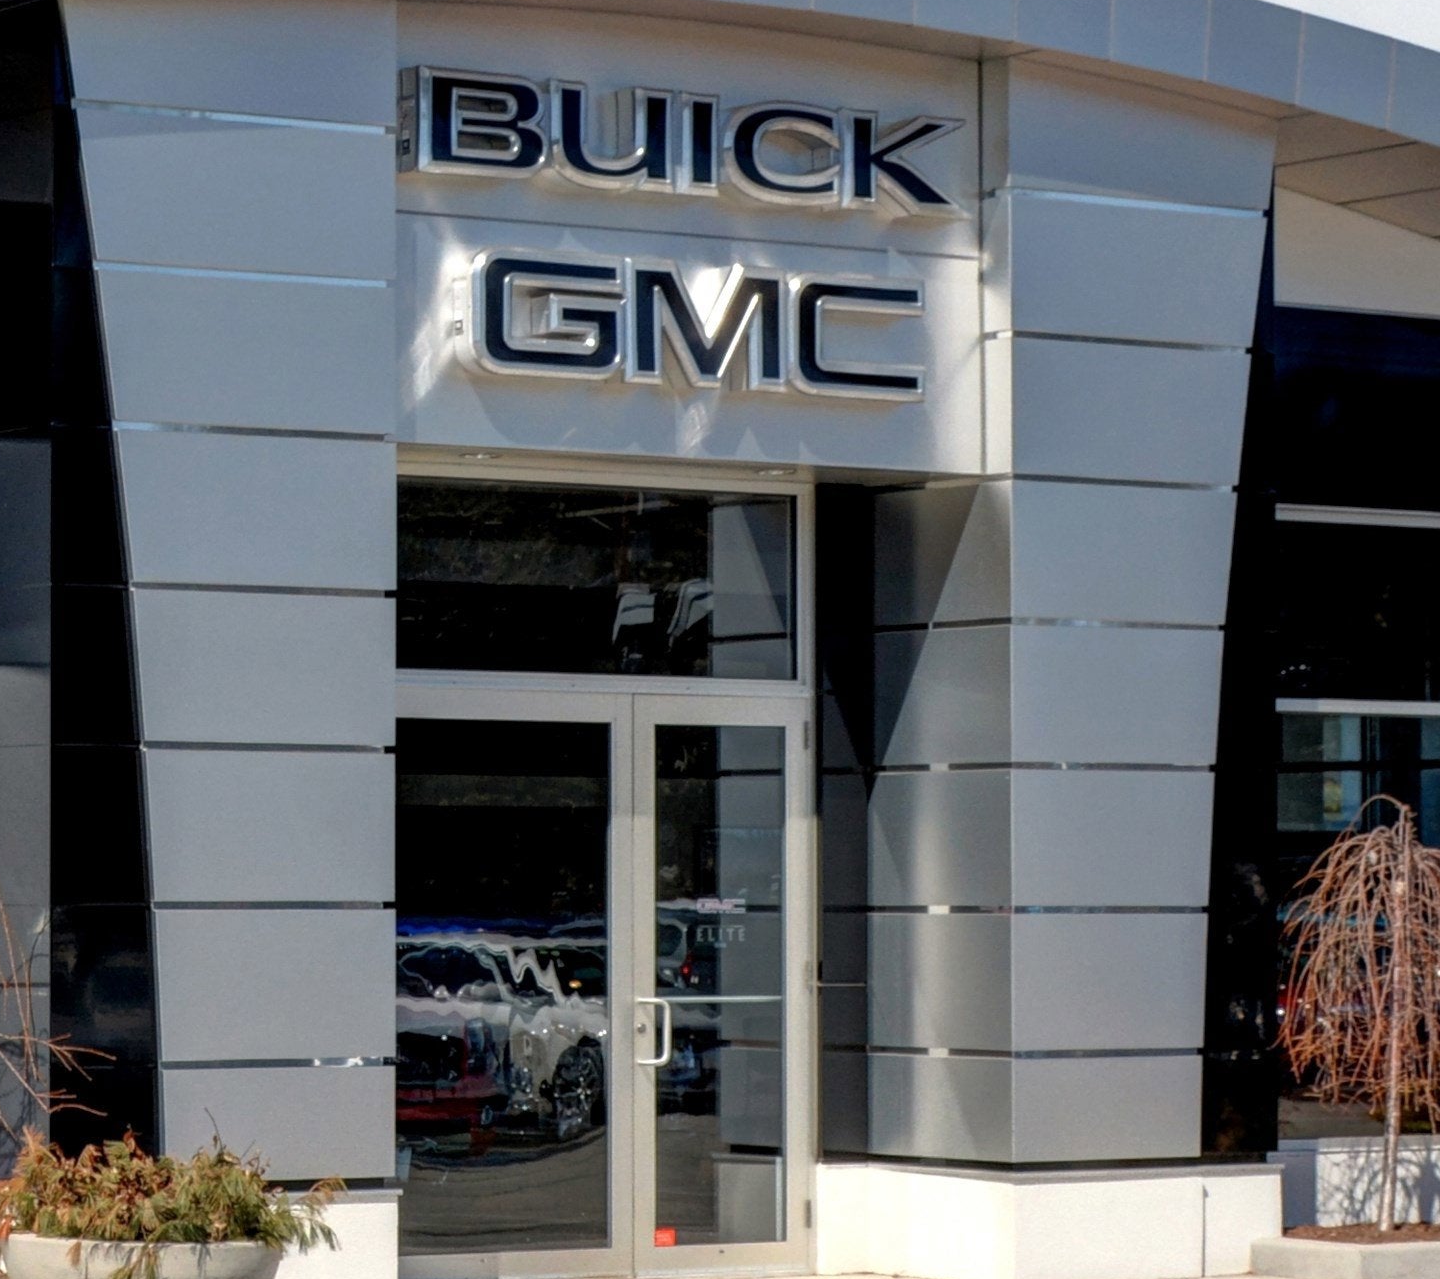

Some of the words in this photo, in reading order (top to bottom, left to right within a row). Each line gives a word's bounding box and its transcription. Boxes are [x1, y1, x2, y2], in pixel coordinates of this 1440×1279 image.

[406, 65, 968, 216] BUICK
[460, 246, 925, 403] GMC
[697, 925, 746, 941] ELITE
